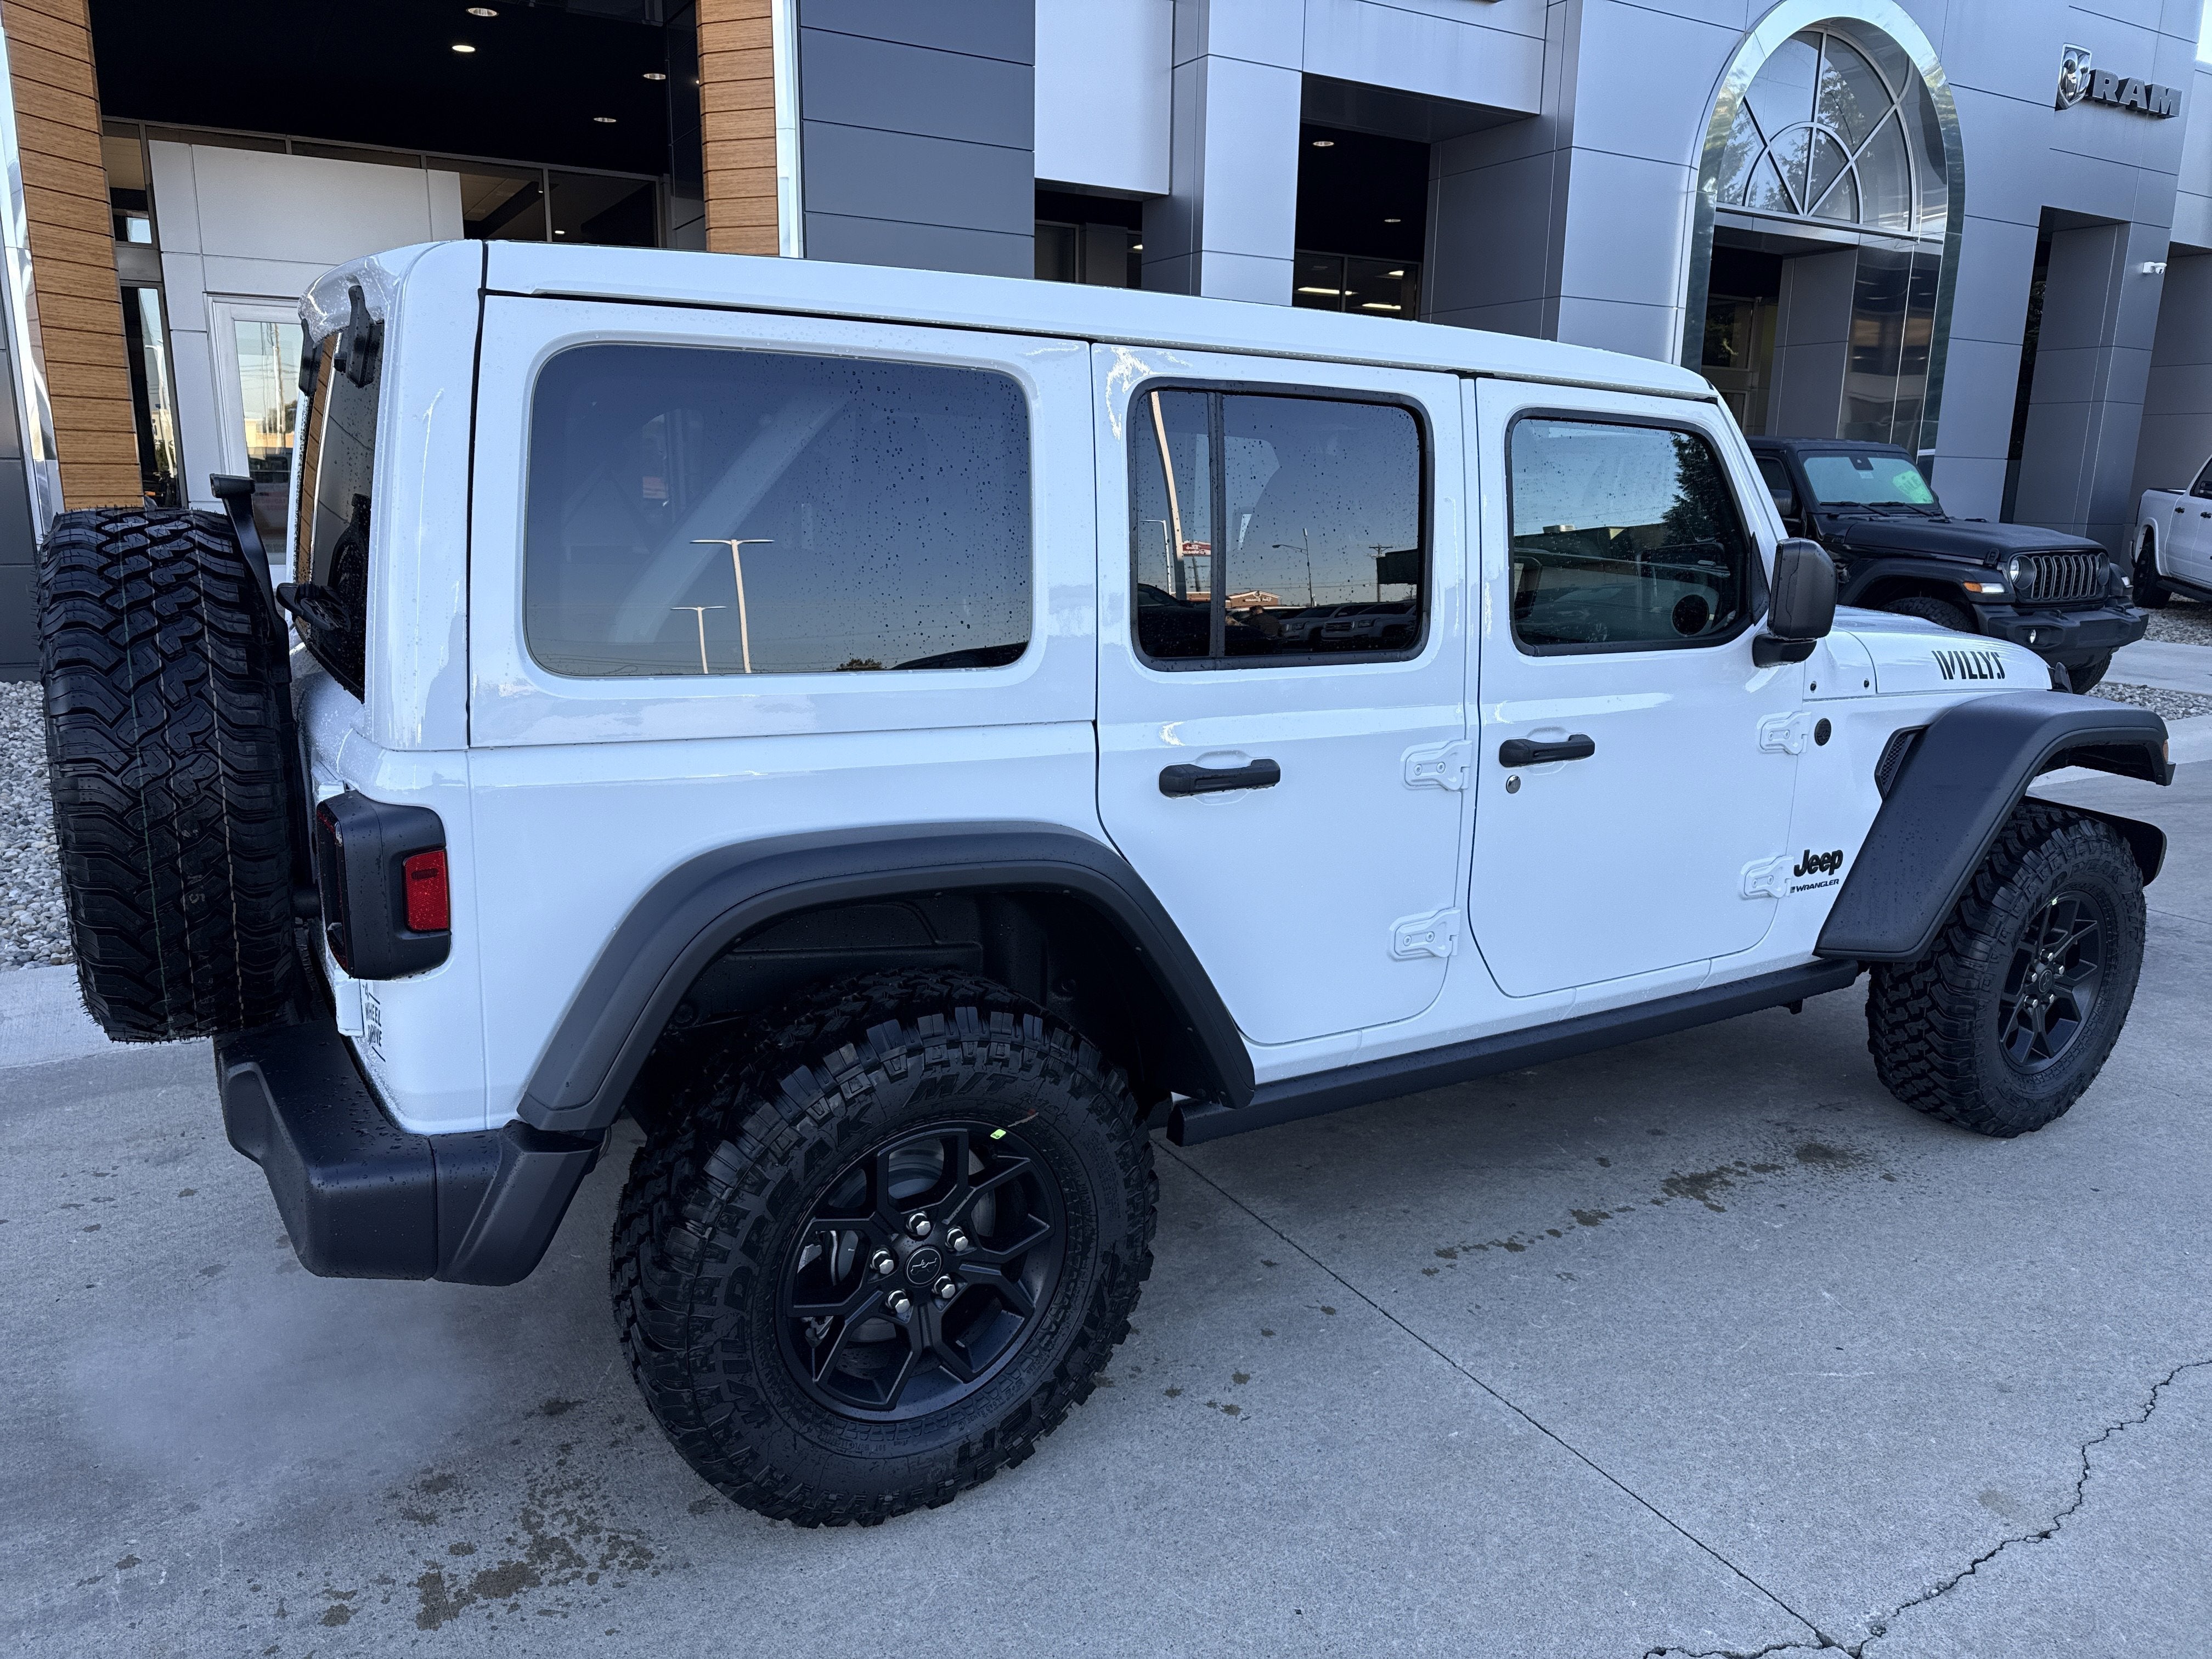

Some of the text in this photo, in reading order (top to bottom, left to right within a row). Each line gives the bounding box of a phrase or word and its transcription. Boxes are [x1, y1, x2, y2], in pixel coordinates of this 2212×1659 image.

[2087, 69, 2182, 119] RAM
[1931, 651, 2005, 680] WILLYS
[1794, 849, 1843, 877] Jeep
[1796, 879, 1839, 893] WRANGLER
[365, 1002, 382, 1028] WHEEL
[368, 1023, 382, 1047] DRIVE
[902, 1071, 1019, 1108] M/T
[722, 1102, 873, 1426] WILDPEAK
[966, 1409, 986, 1424] RANGE
[985, 1398, 1002, 1411] LOAD
